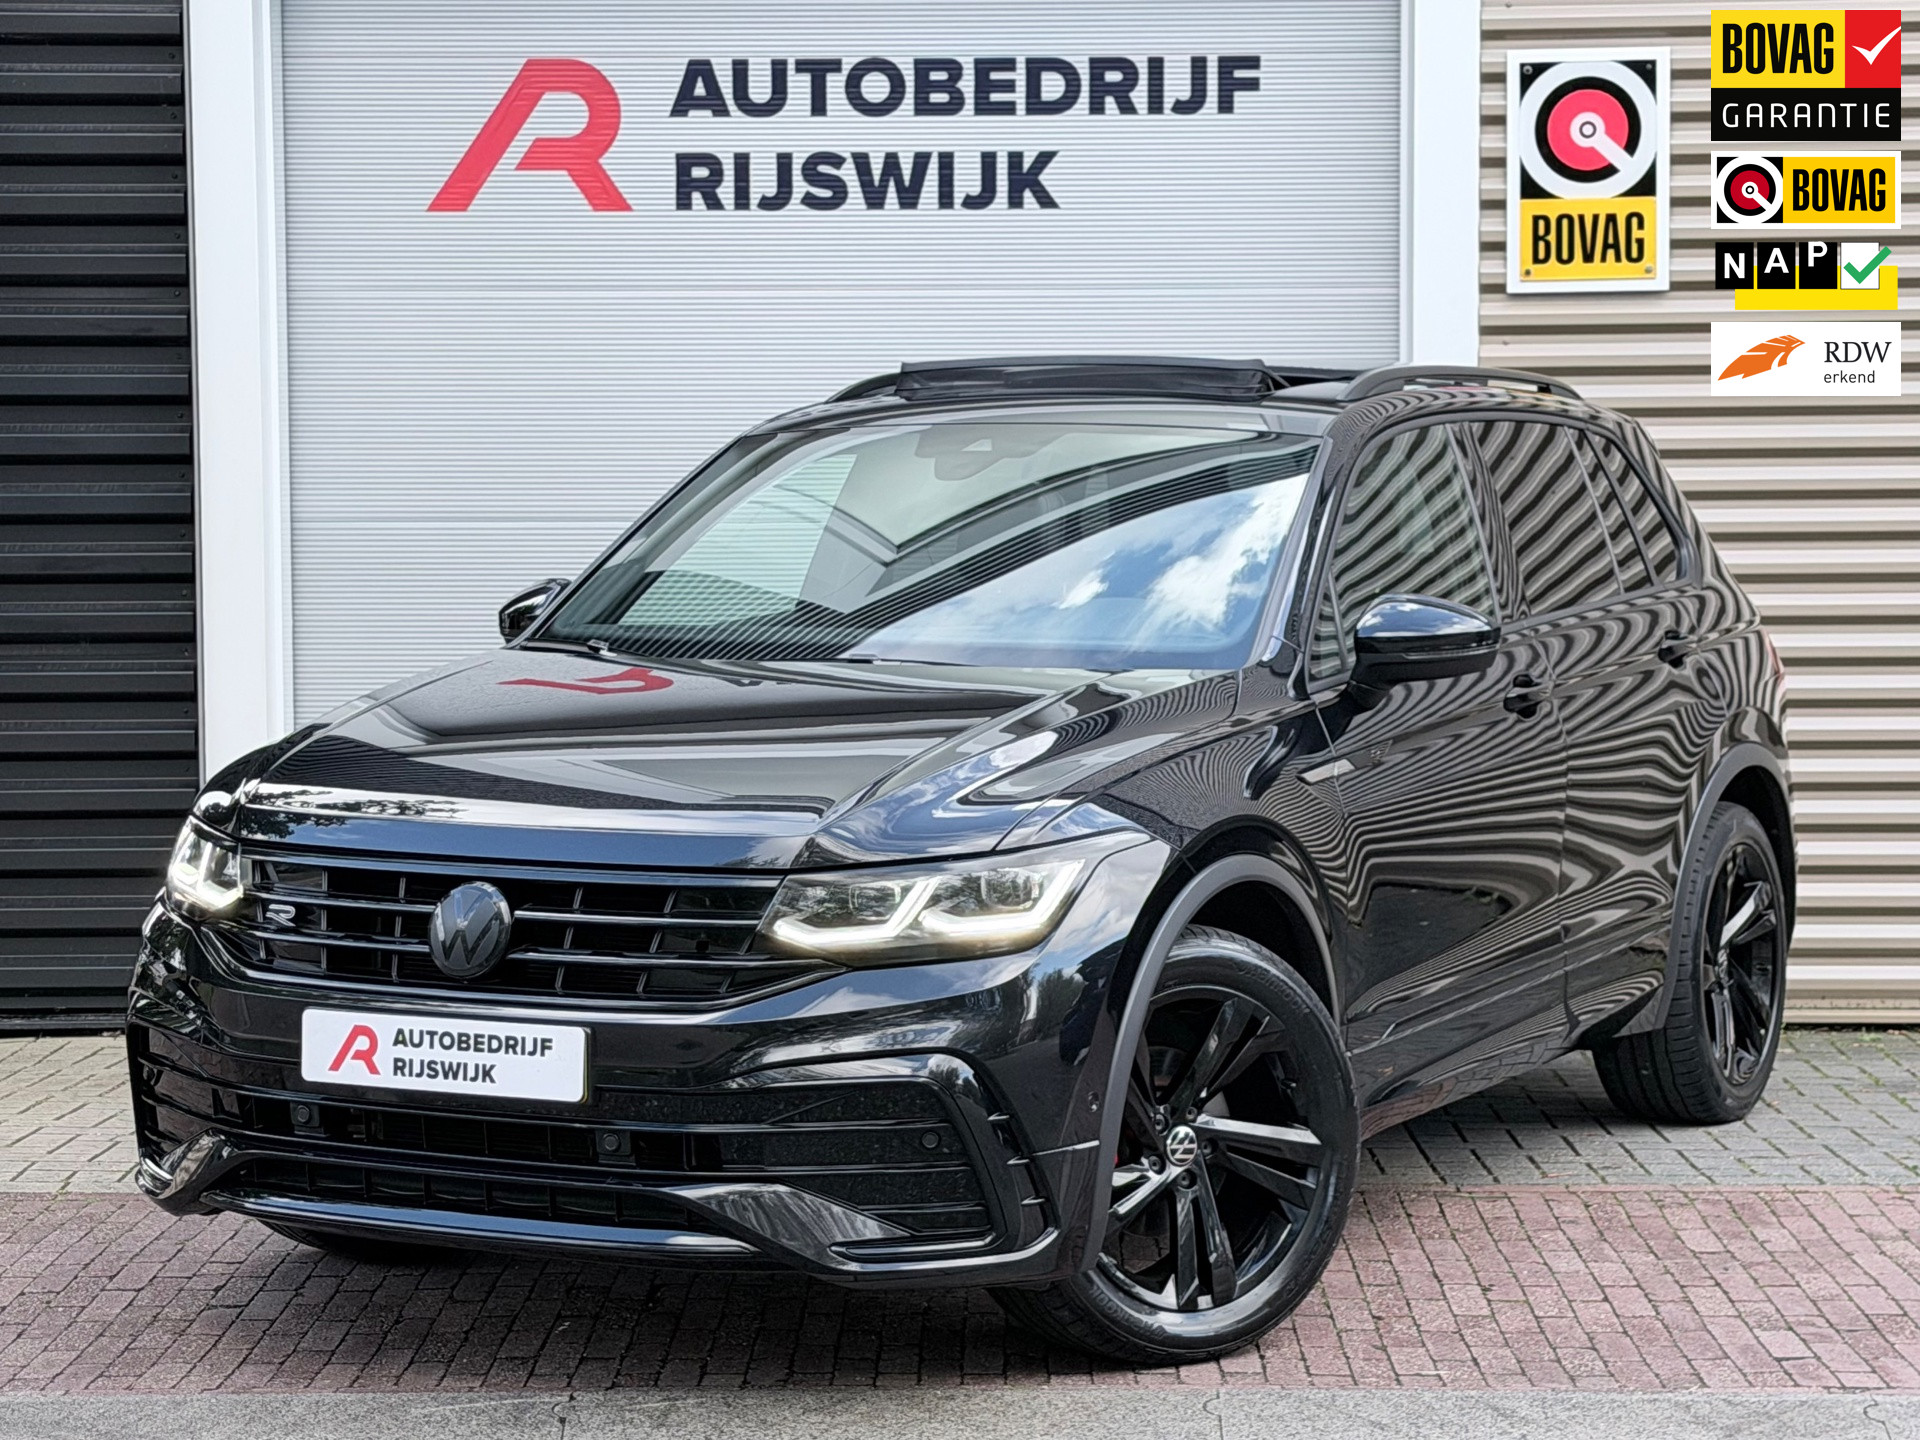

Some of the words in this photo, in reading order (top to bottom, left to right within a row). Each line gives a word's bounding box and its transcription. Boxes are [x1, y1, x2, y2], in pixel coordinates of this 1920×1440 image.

[669, 55, 1261, 118] AUTOBEDRIJF
[675, 150, 1059, 211] RIJSWIJK
[1531, 211, 1646, 266] BOVAG
[392, 1027, 554, 1058] AUTOBEDRIJF
[393, 1057, 497, 1084] RIJSWIJK
